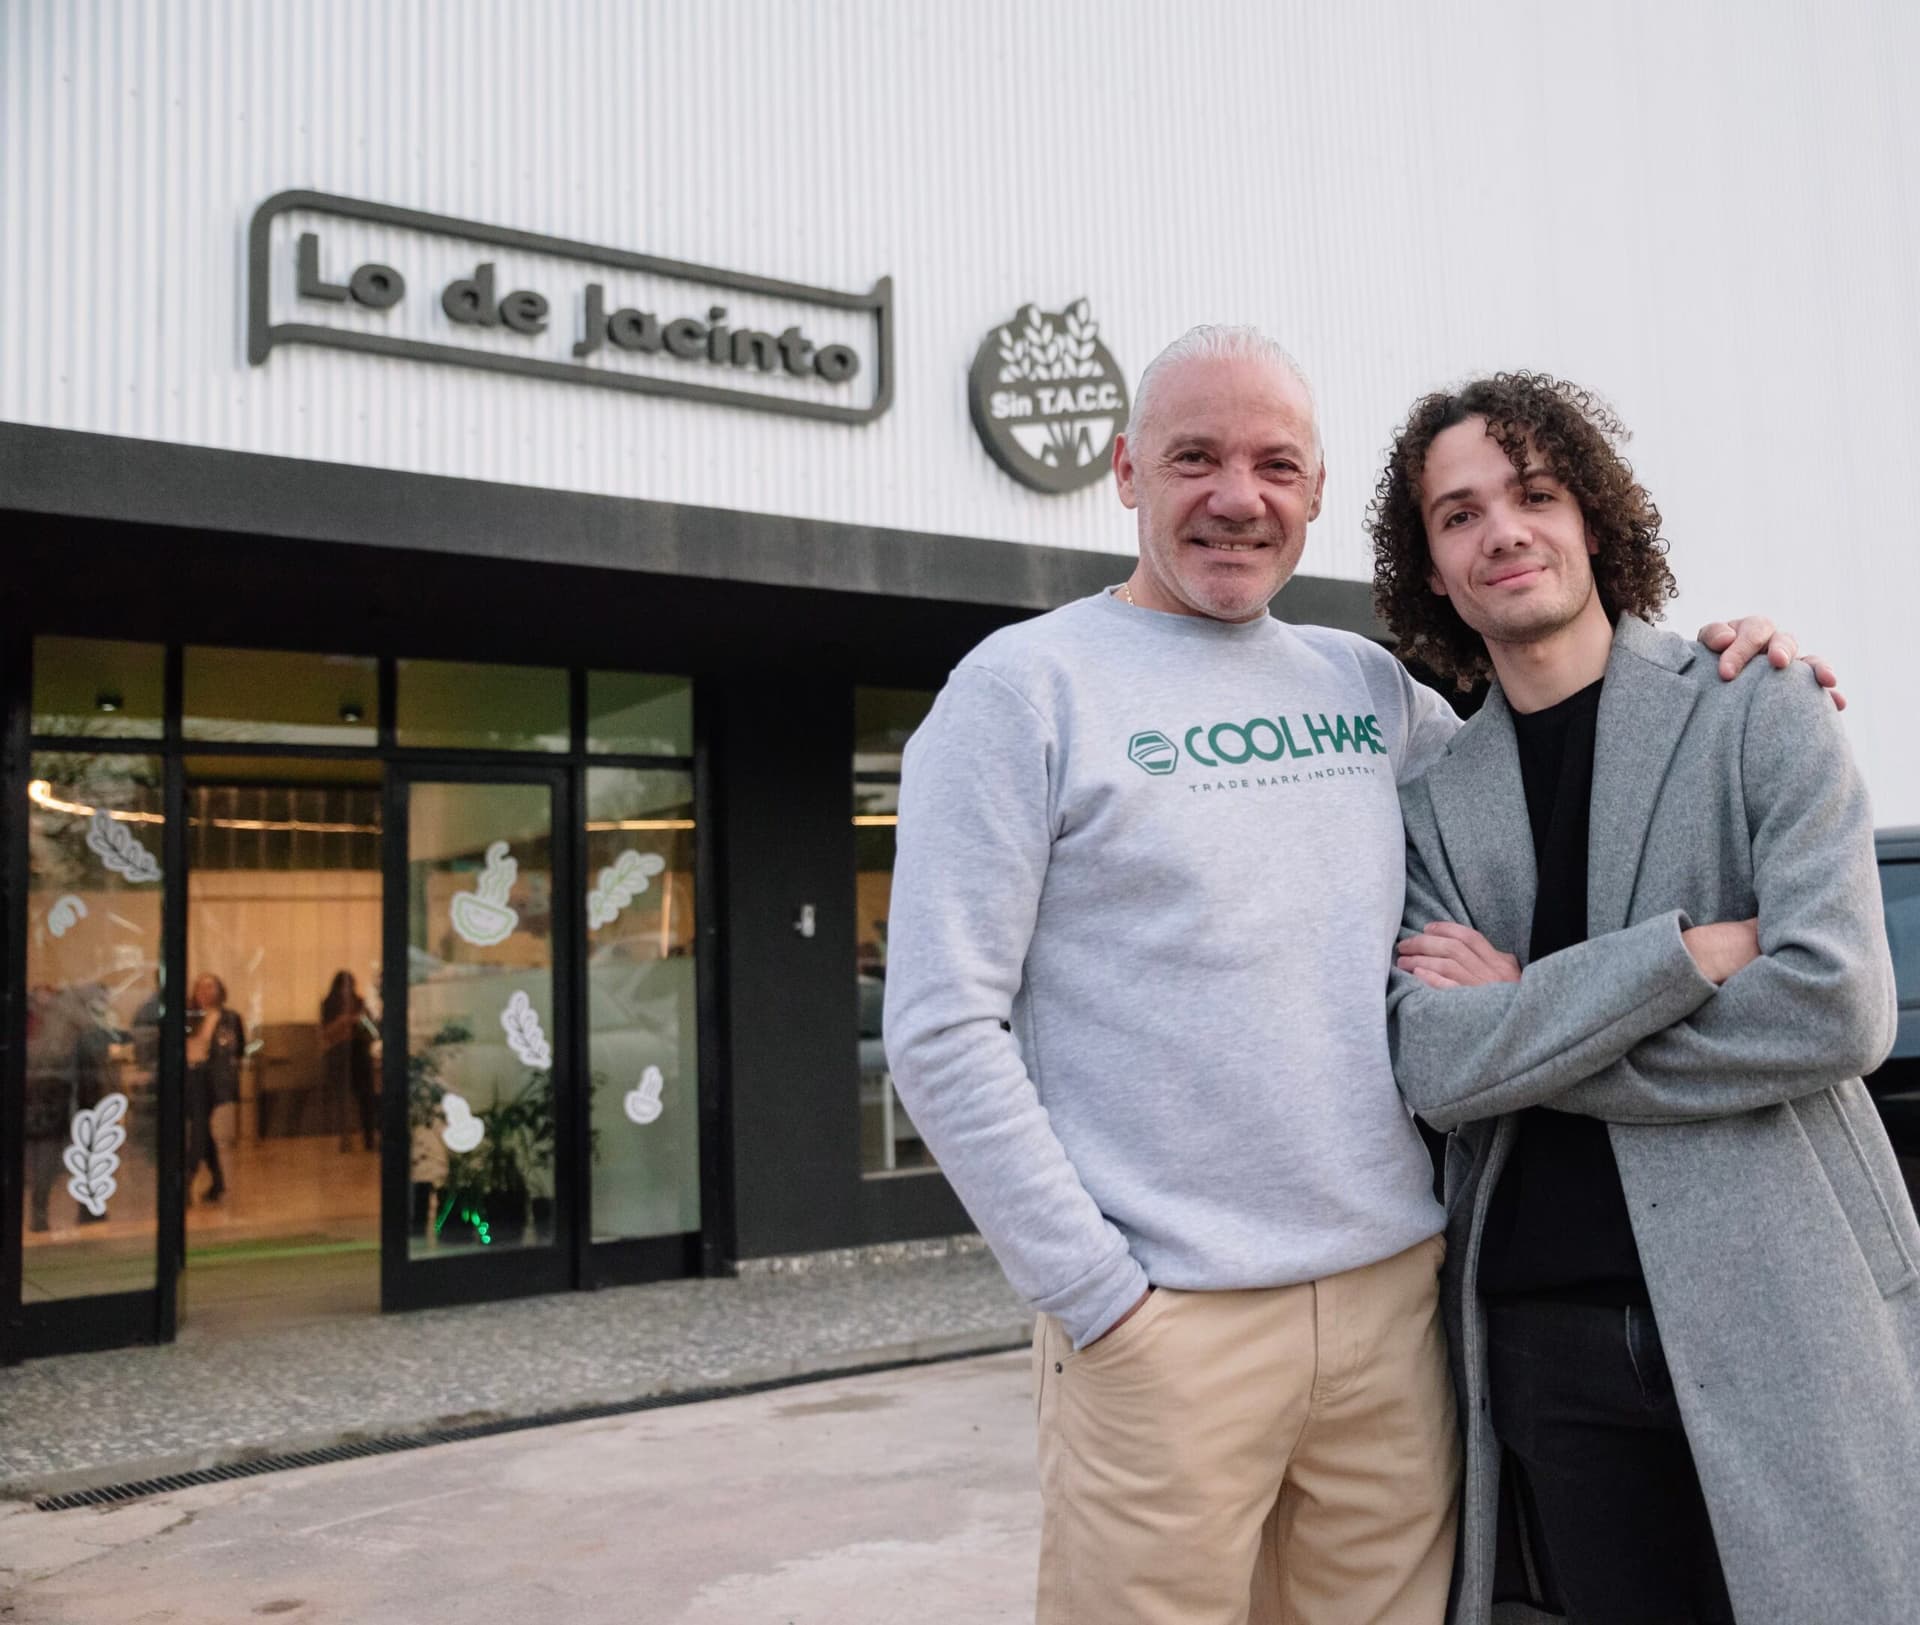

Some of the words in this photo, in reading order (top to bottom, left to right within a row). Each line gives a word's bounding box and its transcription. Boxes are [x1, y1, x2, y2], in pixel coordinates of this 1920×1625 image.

[298, 233, 405, 308] Lo
[442, 263, 549, 333] de
[574, 284, 860, 383] Jacinto
[991, 391, 1033, 418] Sin
[1185, 713, 1387, 767] COOLHAAS
[1190, 779, 1249, 793] TRADE
[1257, 774, 1300, 788] MARK
[1308, 766, 1376, 781] INDUSTRY
